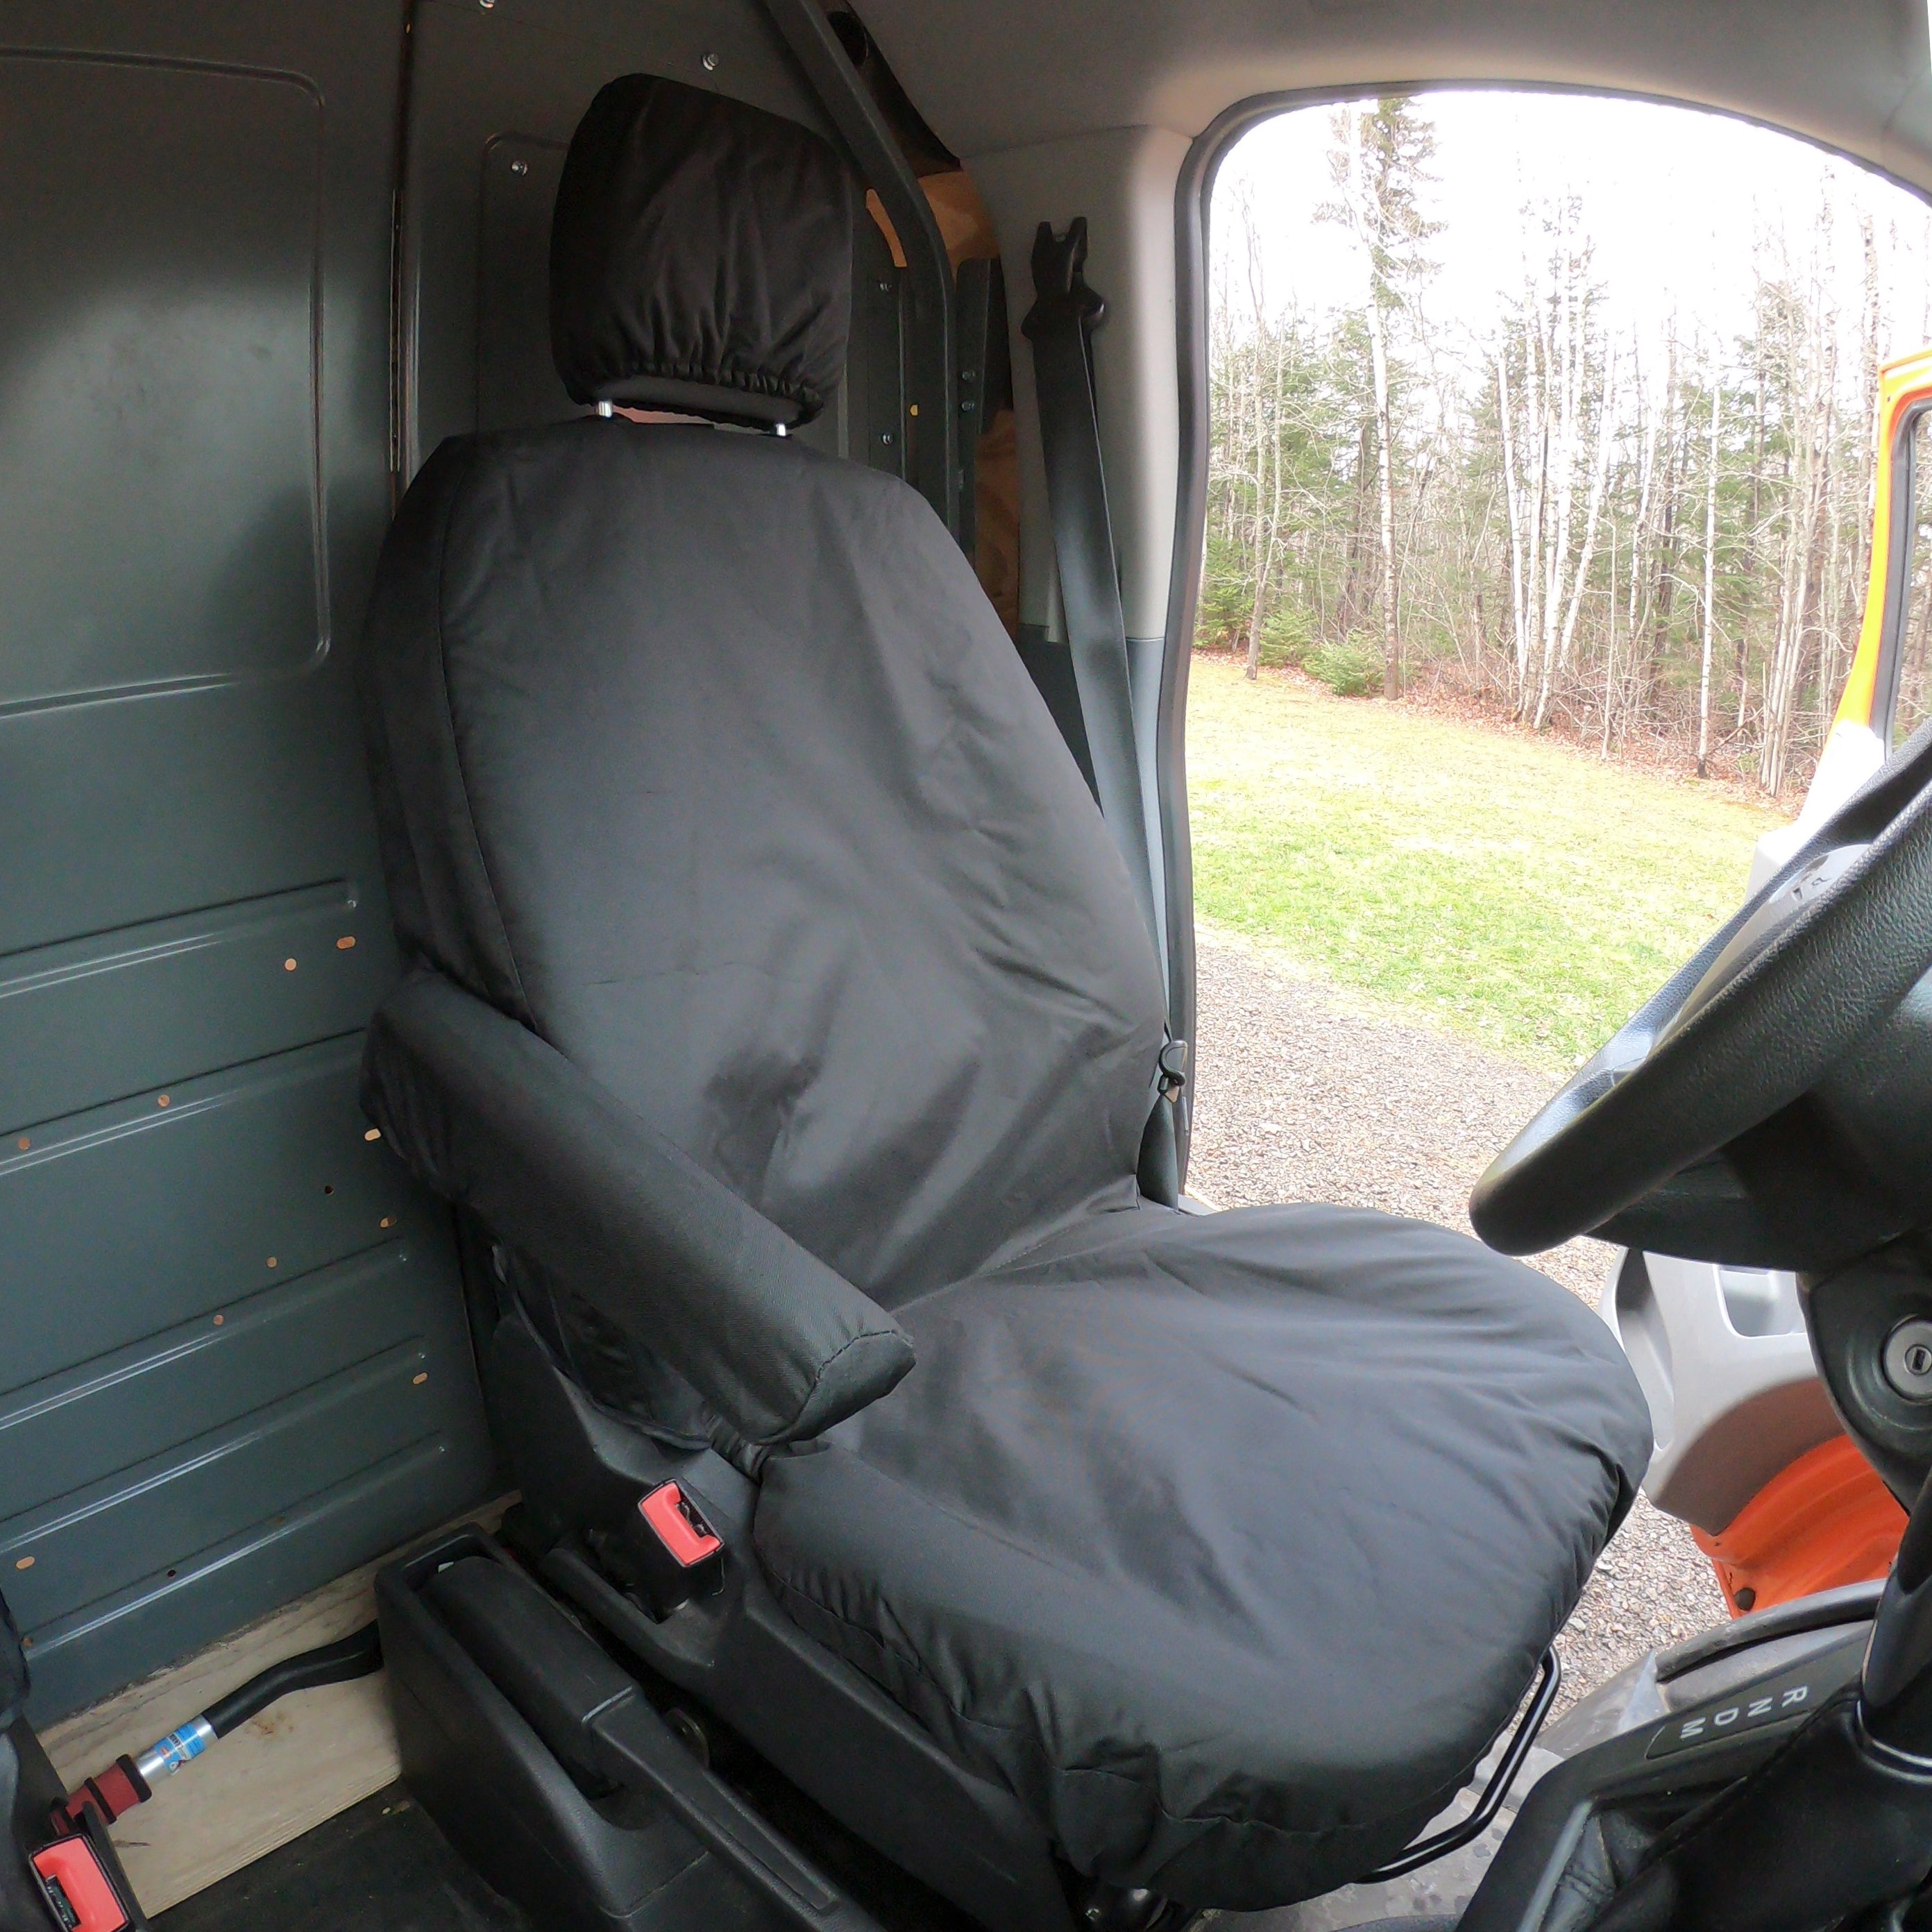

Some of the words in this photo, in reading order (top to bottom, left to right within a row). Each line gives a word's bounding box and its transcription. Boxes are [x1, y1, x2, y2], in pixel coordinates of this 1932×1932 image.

[1747, 1697, 1773, 1717] N
[1781, 1686, 1808, 1708] R
[1713, 1707, 1739, 1726] D
[1680, 1717, 1706, 1738] M
